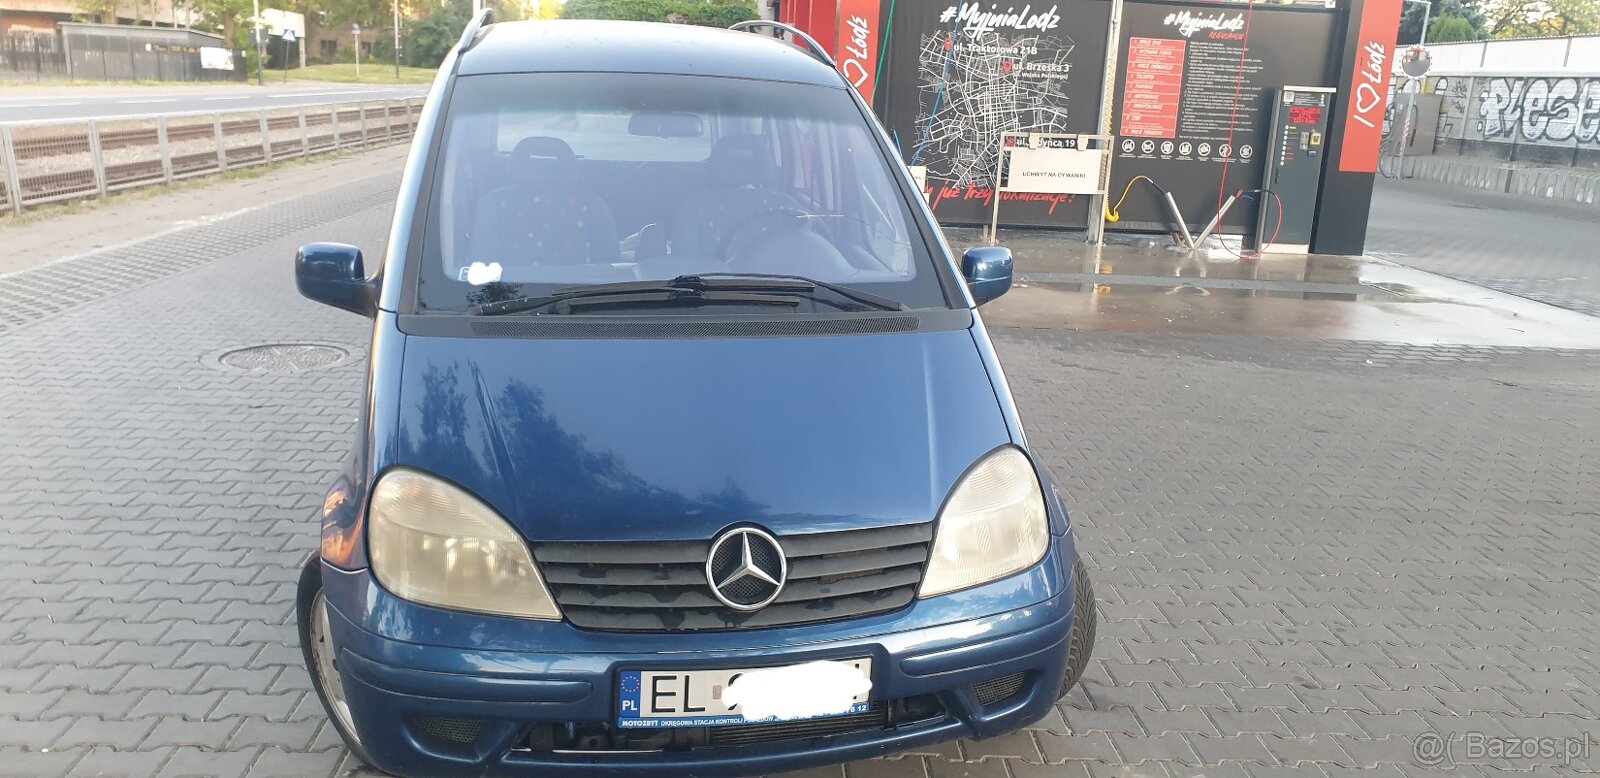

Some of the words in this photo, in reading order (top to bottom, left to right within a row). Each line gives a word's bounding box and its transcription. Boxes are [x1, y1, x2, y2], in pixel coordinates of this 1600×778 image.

[845, 14, 871, 60] Łódź
[953, 44, 965, 52] ul.
[967, 44, 1018, 54] Traktorowa
[1020, 46, 1038, 55] 21B
[1026, 63, 1062, 72] Brzeska
[1063, 64, 1070, 72] 3
[1360, 40, 1387, 84] Łódź
[1065, 139, 1076, 147] 19
[651, 674, 706, 713] EL
[622, 700, 638, 711] PL
[715, 717, 743, 725] KONTROLI
[857, 704, 867, 712] 12
